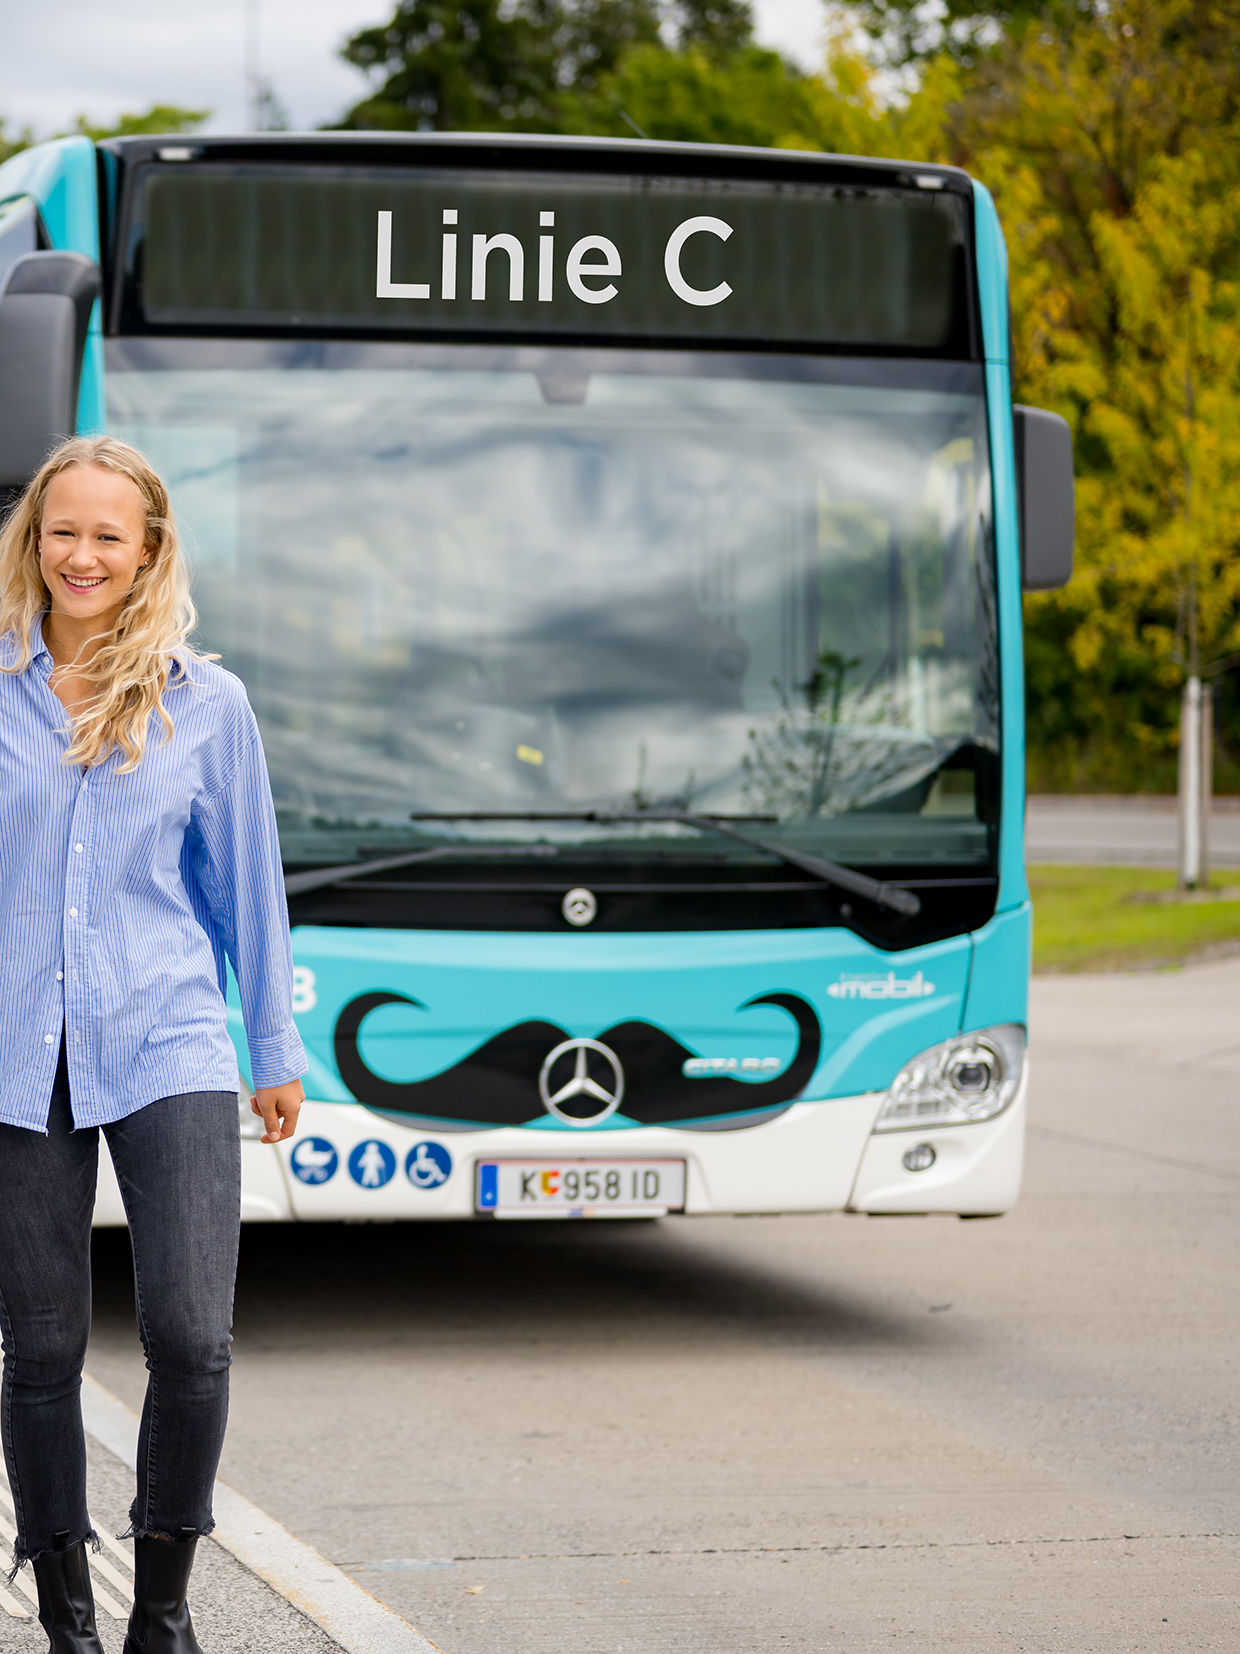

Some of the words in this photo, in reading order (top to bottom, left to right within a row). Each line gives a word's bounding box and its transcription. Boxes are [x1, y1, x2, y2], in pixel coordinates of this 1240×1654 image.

[375, 208, 623, 305] Linie
[664, 215, 734, 306] C
[521, 1170, 537, 1200] K
[564, 1170, 620, 1200] 958
[632, 1170, 659, 1200] ID
